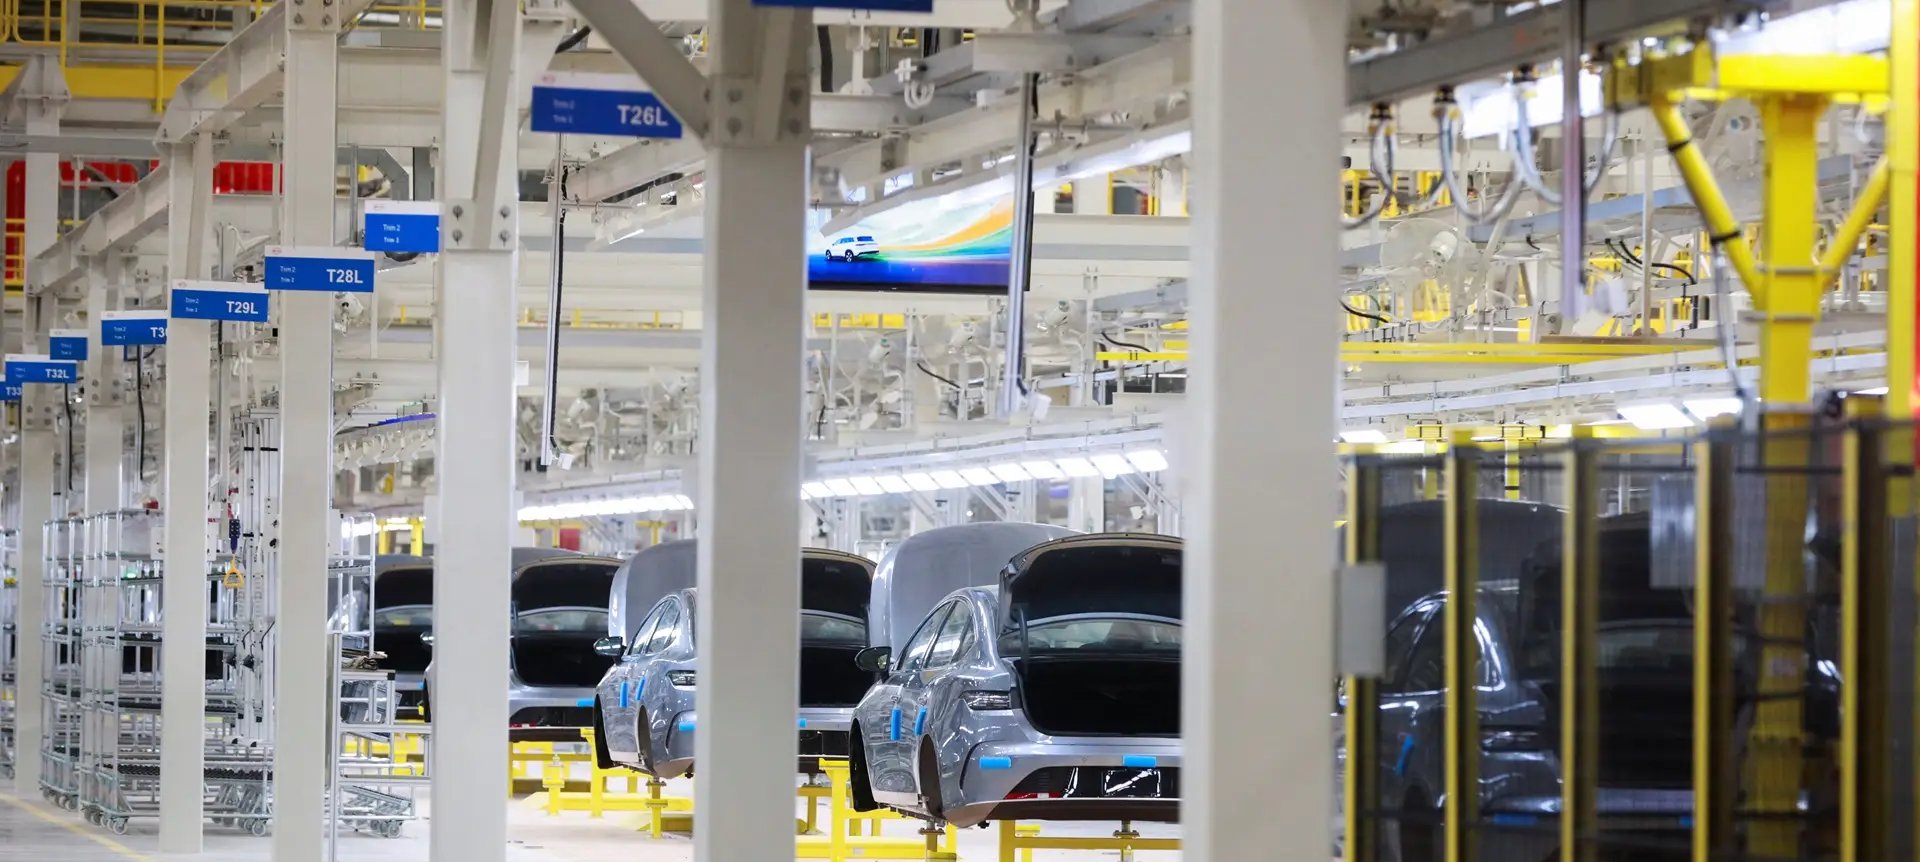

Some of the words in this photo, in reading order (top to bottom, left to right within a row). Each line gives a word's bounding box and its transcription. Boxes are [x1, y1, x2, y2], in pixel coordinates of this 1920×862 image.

[617, 105, 669, 126] T26L
[326, 269, 363, 284] T28L
[226, 301, 258, 314] T29L
[150, 327, 167, 338] T3
[45, 368, 70, 379] T32L
